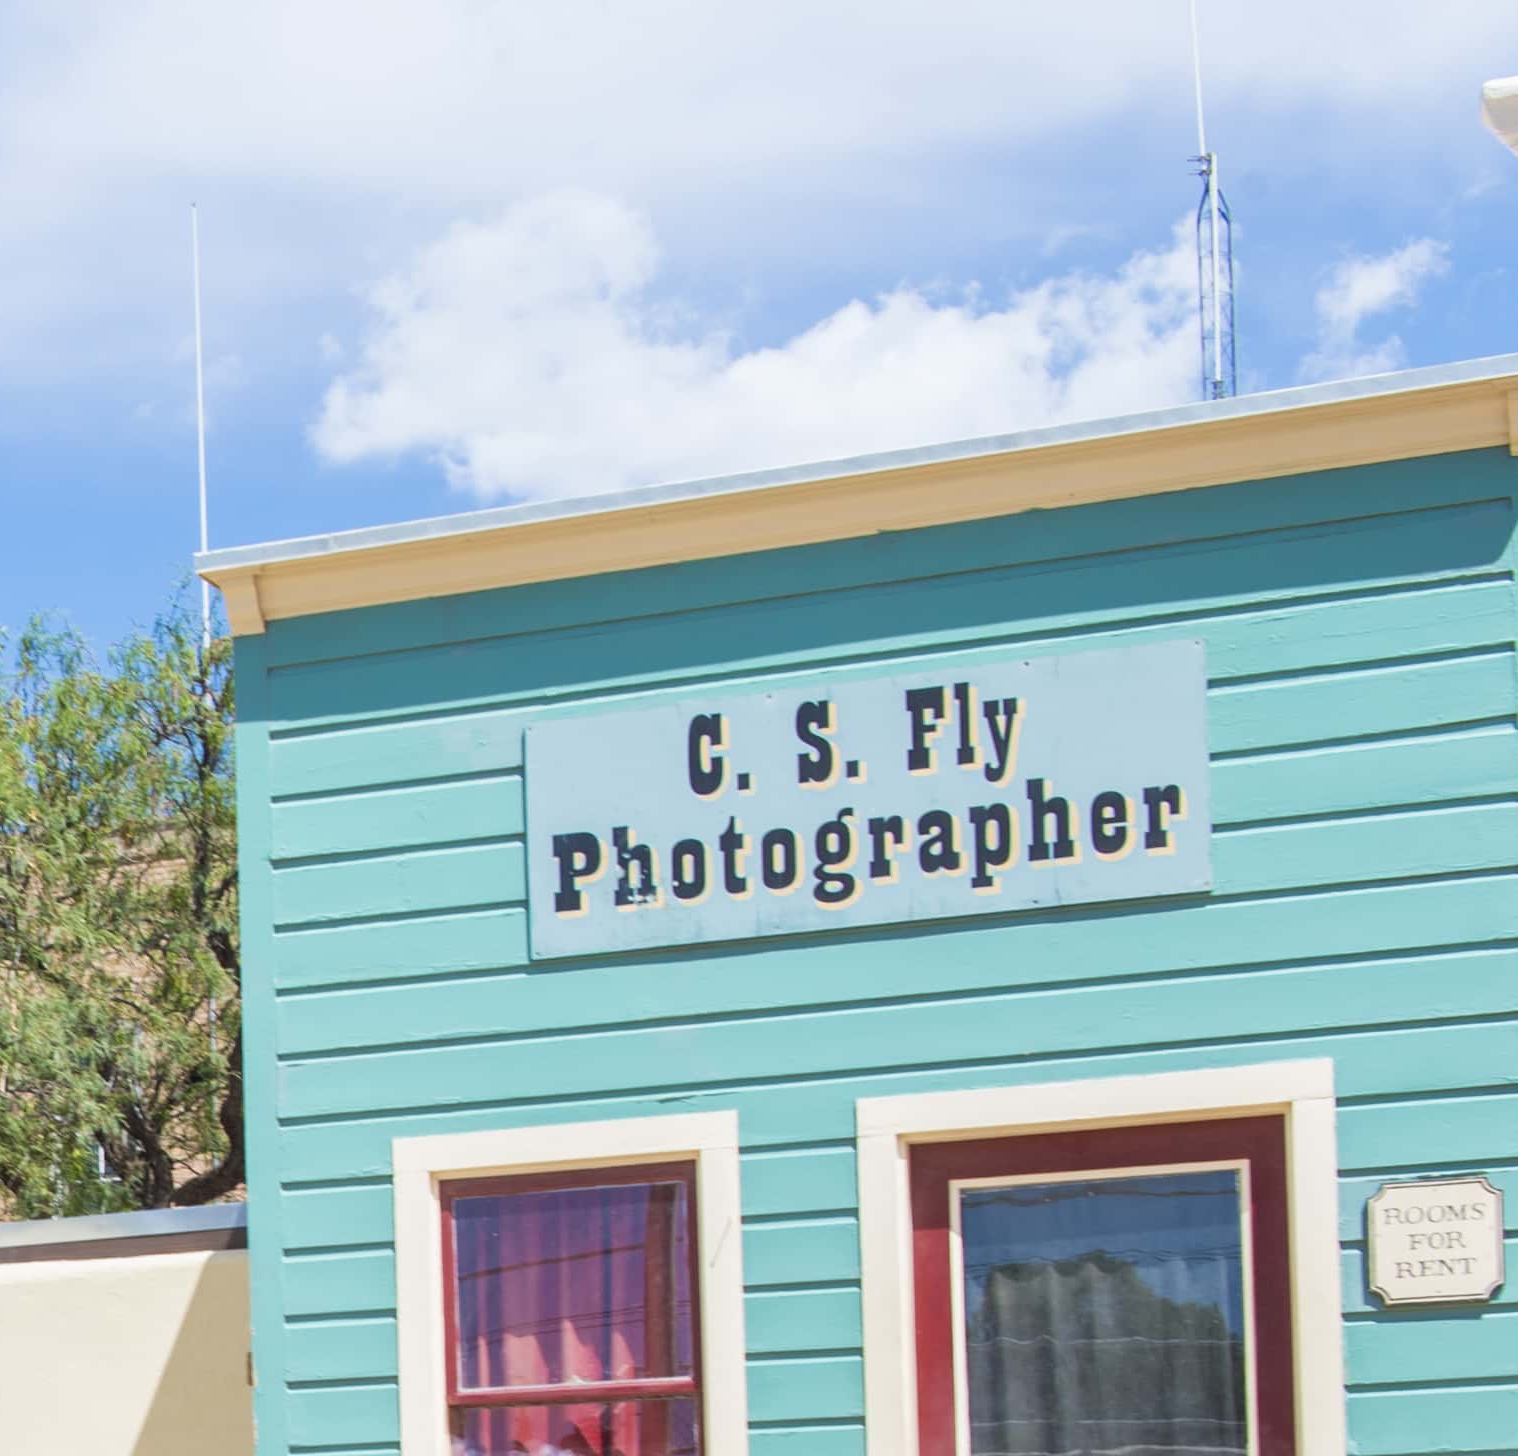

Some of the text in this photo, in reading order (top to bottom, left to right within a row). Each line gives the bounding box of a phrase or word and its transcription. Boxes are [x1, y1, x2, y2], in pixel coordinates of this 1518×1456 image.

[688, 682, 1024, 796] C. S. Fly
[552, 778, 1185, 914] Photographer
[1383, 1203, 1485, 1225] ROOMS
[1407, 1231, 1466, 1250] FOR
[1394, 1257, 1477, 1279] RENT
